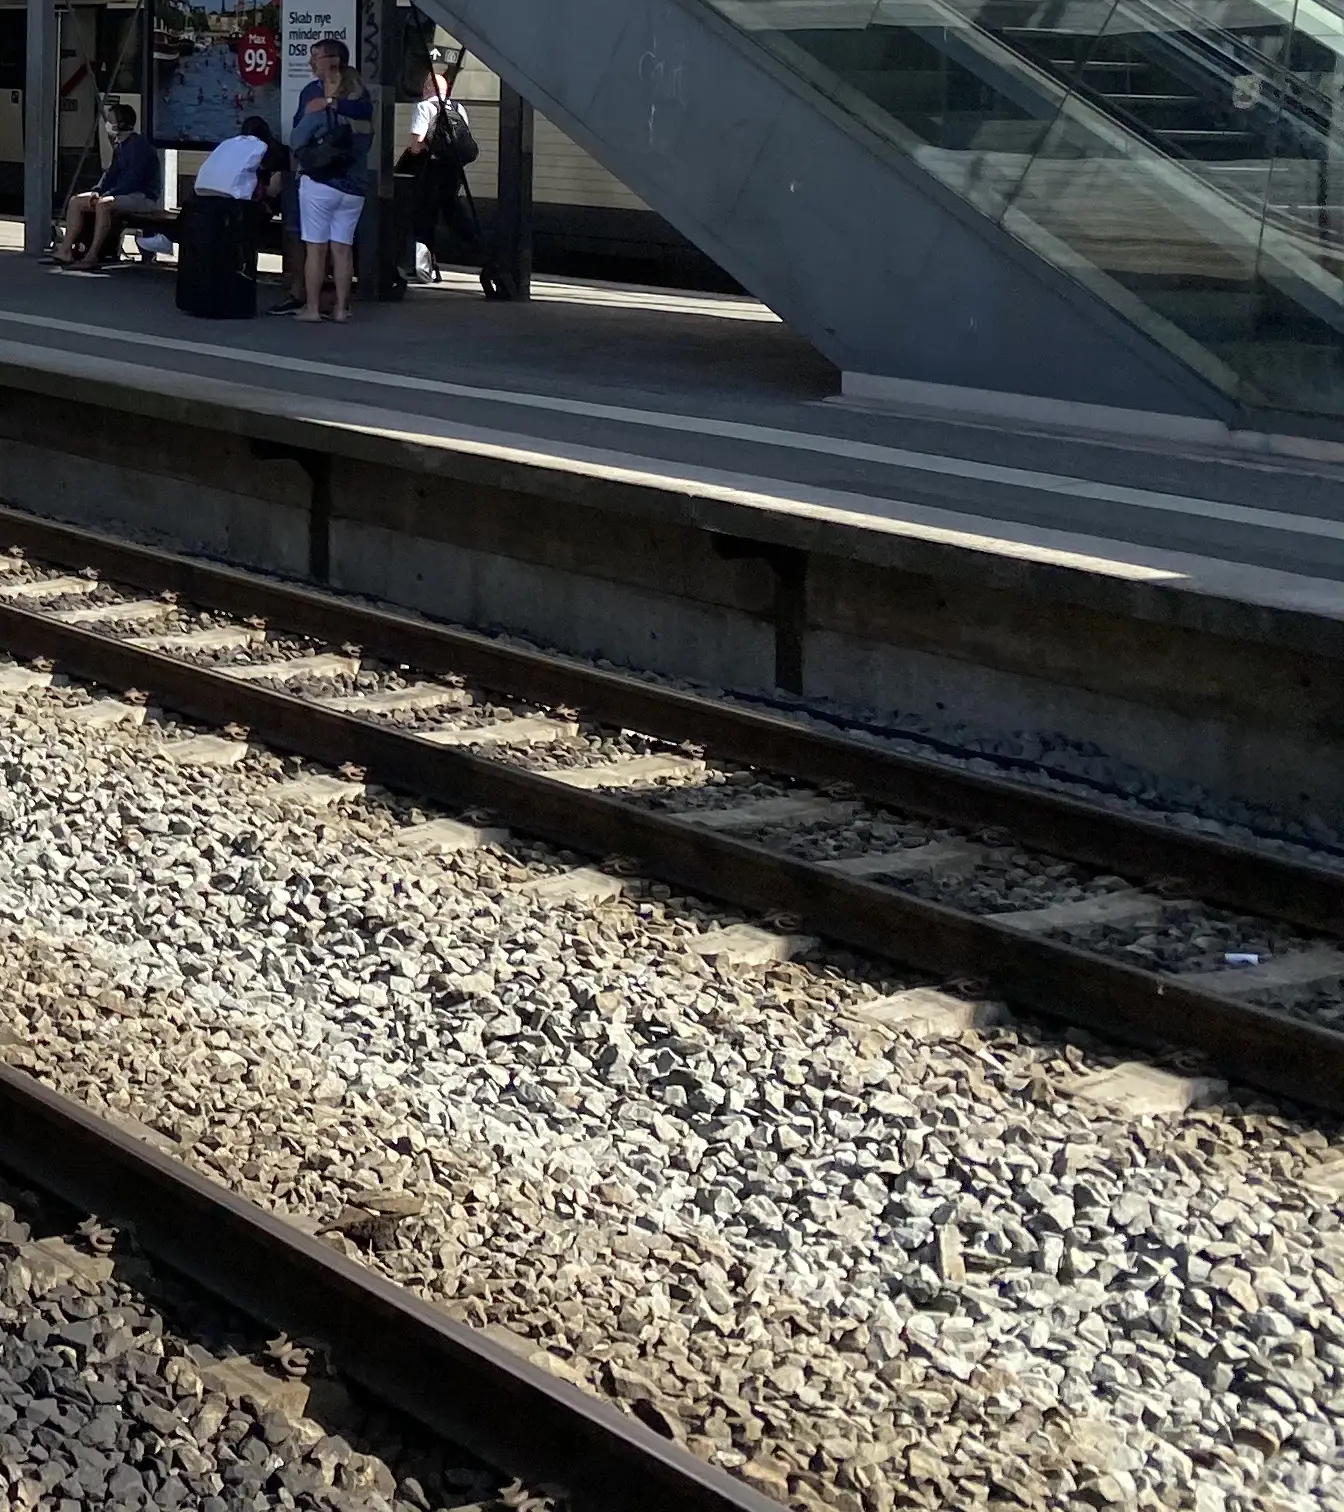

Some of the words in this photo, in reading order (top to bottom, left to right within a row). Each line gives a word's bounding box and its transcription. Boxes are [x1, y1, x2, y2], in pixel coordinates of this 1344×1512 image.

[289, 11, 312, 24] Skab
[314, 14, 332, 27] nye
[248, 33, 267, 45] Max
[289, 27, 322, 40] minder
[324, 27, 347, 40] med
[288, 43, 308, 57] DSB
